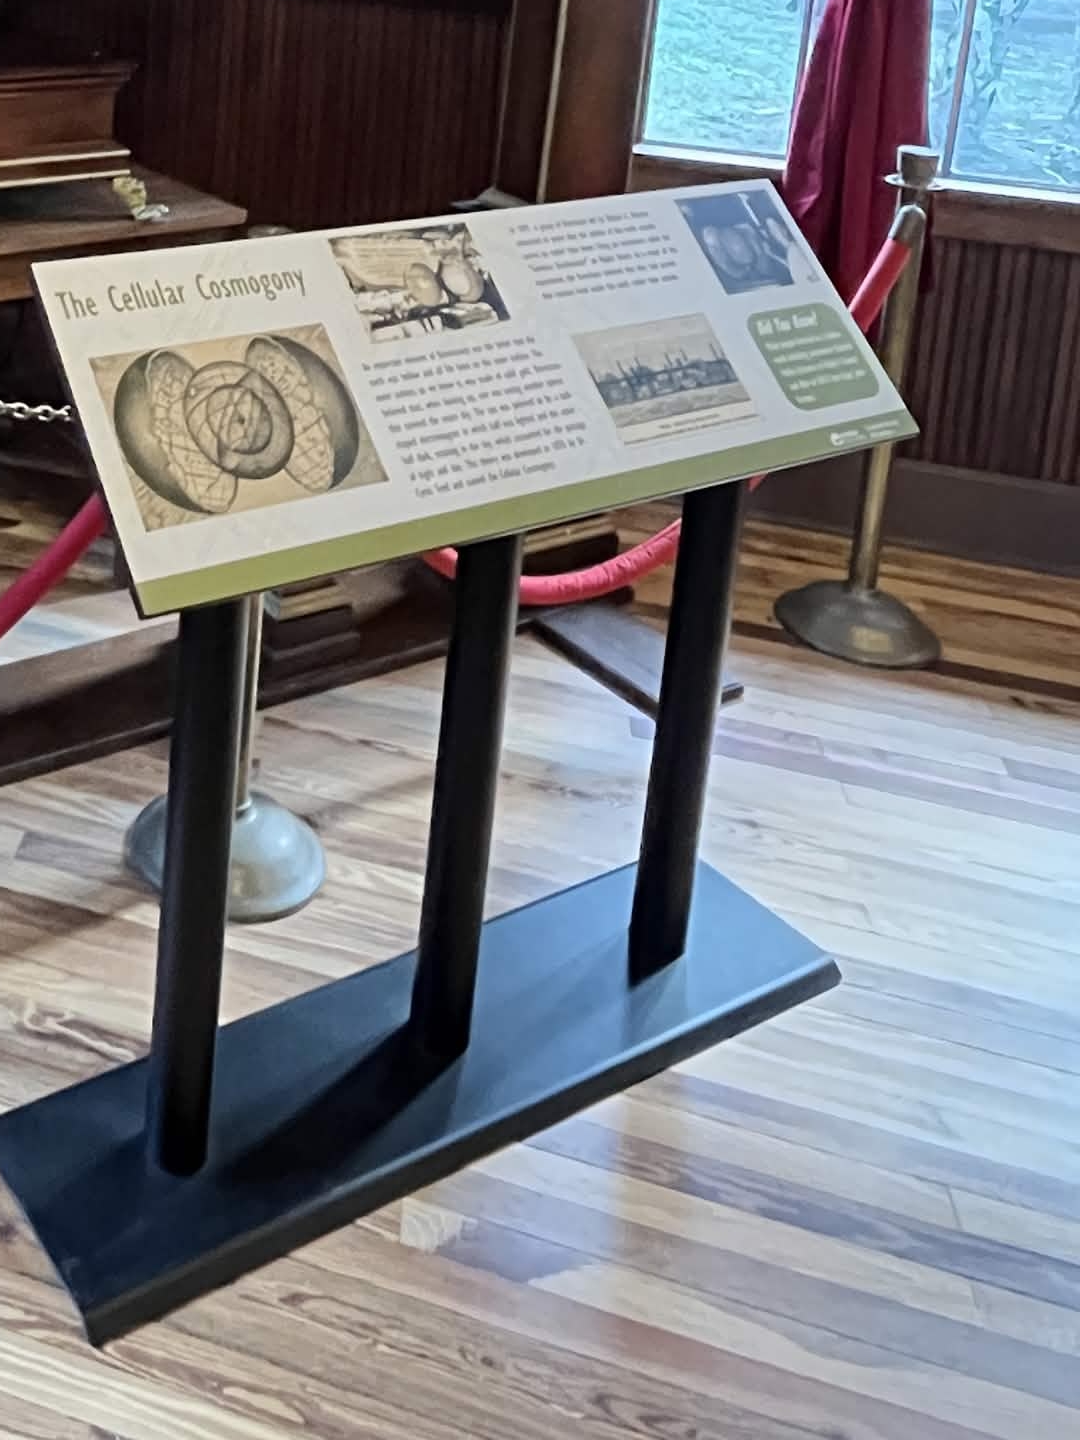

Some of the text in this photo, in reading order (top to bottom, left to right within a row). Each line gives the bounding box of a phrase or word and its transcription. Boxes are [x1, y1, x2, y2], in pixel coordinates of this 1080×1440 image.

[55, 269, 307, 320] The Cellular Cosmogony
